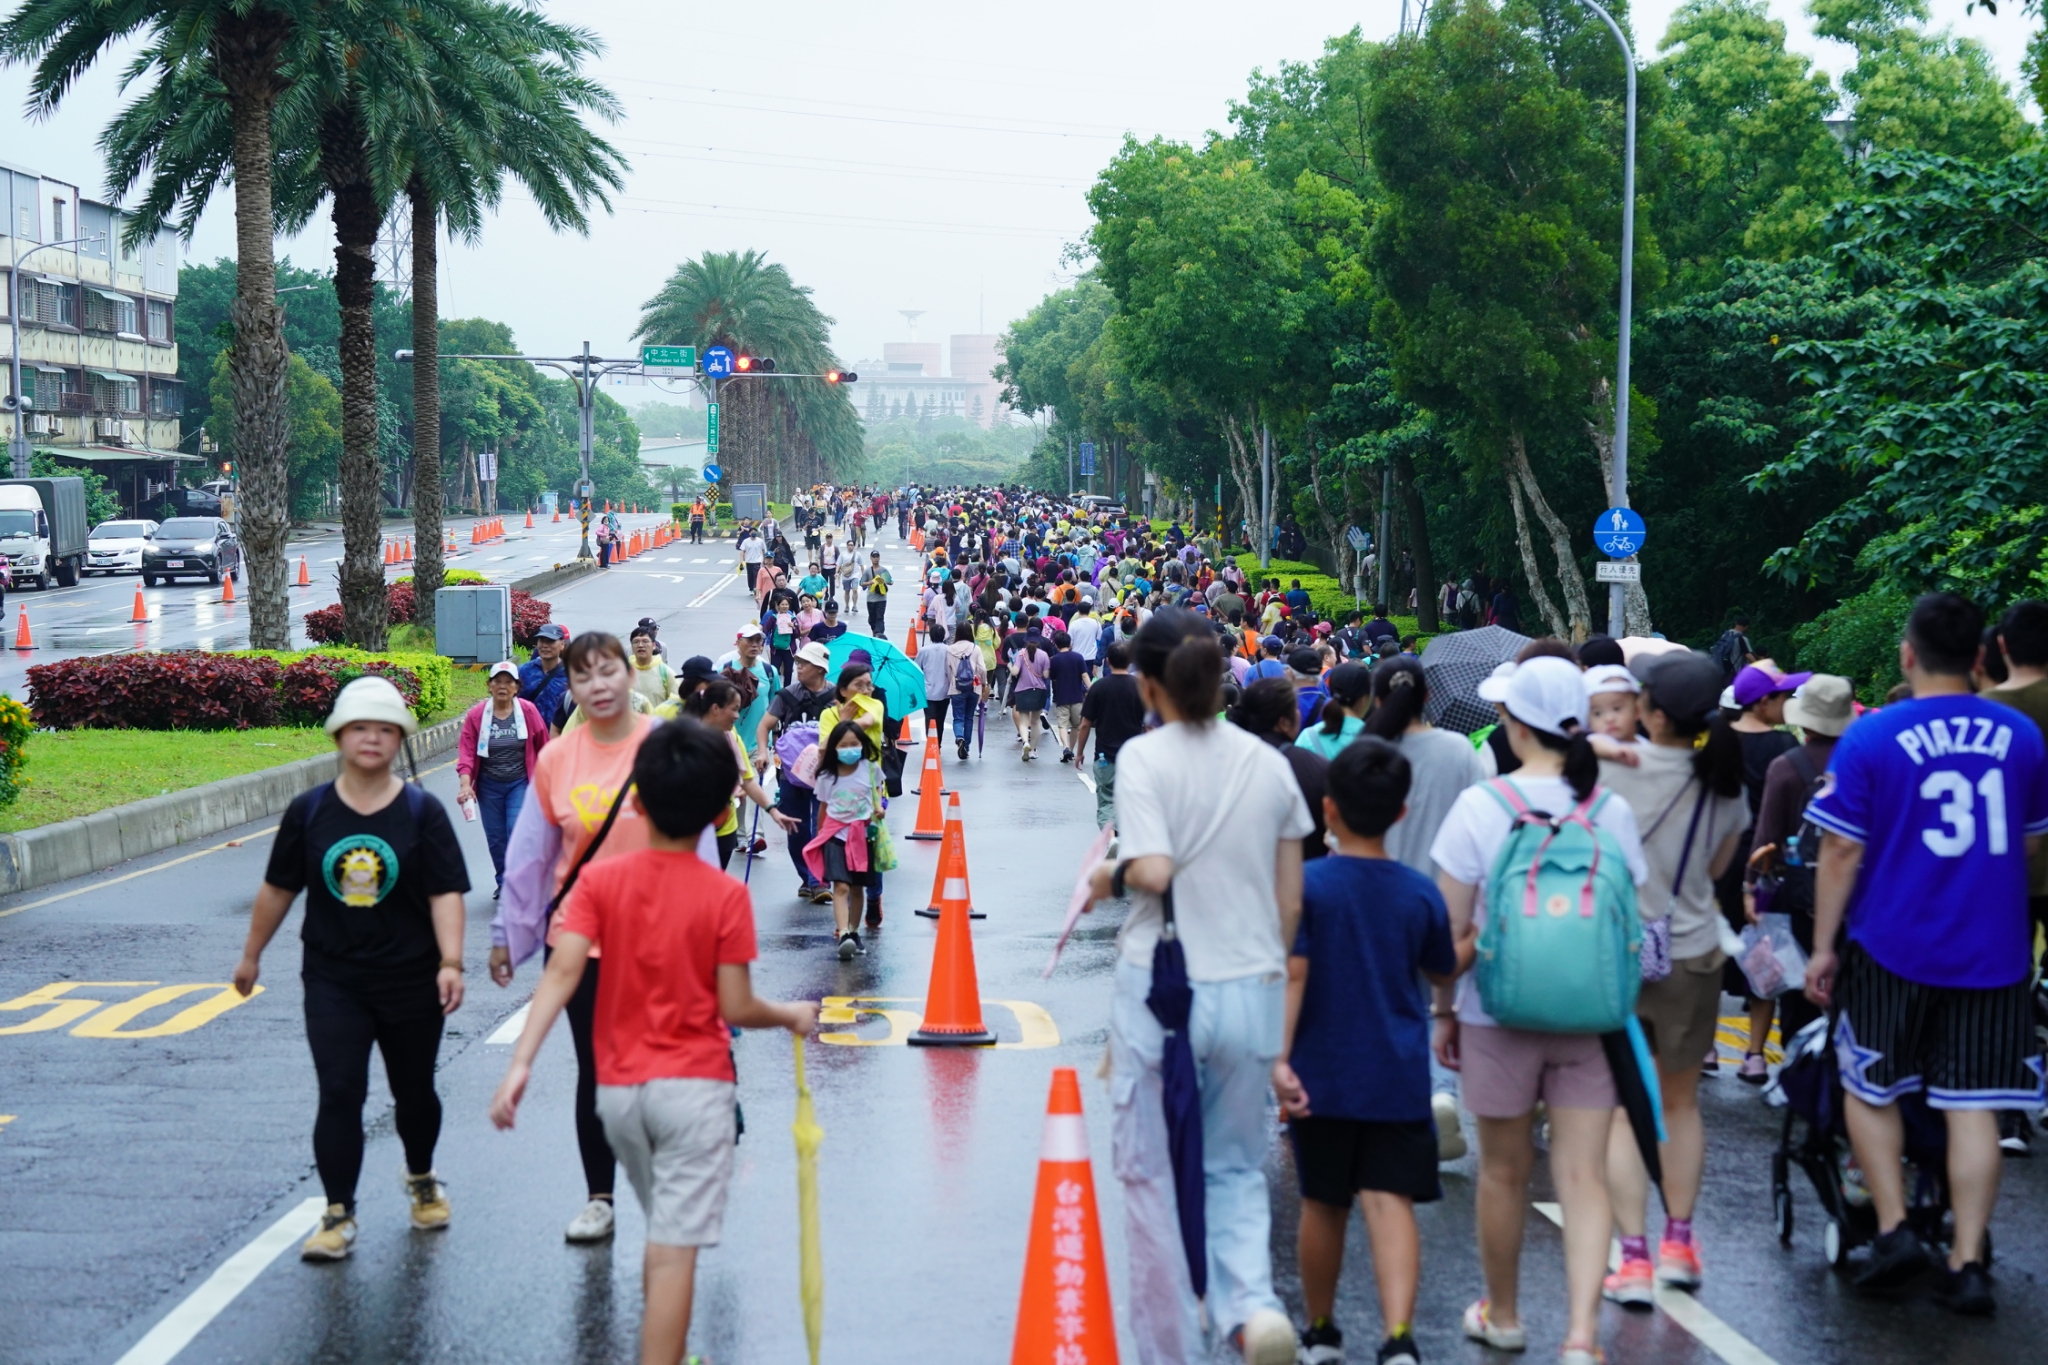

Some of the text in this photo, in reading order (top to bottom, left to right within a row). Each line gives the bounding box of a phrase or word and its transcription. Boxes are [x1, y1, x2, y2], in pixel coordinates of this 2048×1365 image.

[650, 348, 688, 358] 中北一街
[1600, 565, 1636, 574] 行人優先
[1896, 716, 2013, 765] PIAZZA
[1919, 768, 2008, 858] 31
